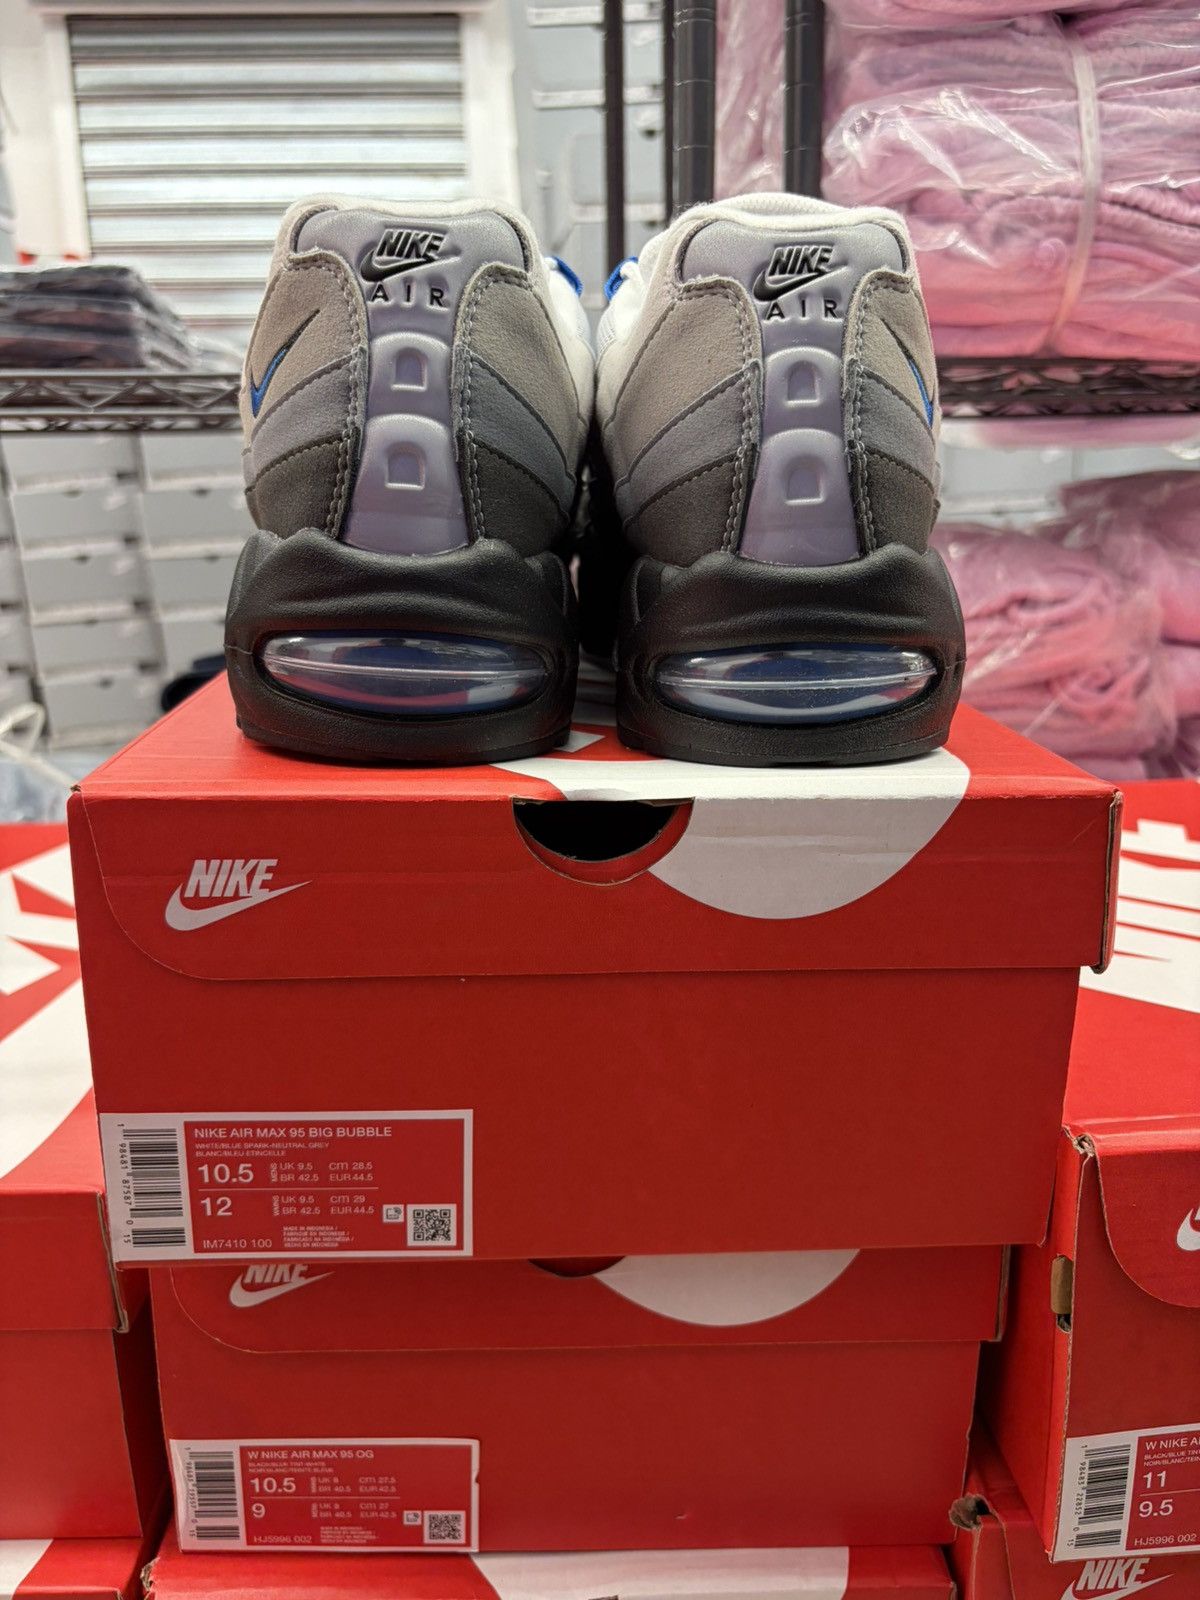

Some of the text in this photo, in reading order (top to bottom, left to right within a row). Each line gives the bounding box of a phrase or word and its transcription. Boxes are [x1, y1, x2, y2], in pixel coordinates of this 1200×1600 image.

[376, 229, 446, 260] NIKE
[768, 246, 834, 276] NIKE
[371, 284, 444, 306] AIR
[766, 300, 838, 320] AIR
[184, 858, 278, 898] NIKE
[194, 1126, 392, 1138] NIKE AIR MAX 95 BIG BUBBLE
[195, 1142, 242, 1150] WHITE/BLUE
[119, 1142, 128, 1170] 98481
[198, 1163, 254, 1184] 10.5
[280, 1162, 295, 1171] UK
[297, 1162, 313, 1170] 9.5
[352, 1162, 373, 1170] 28.5
[280, 1173, 374, 1182] BR 42.5 EUR 44.5
[122, 1179, 132, 1206] 87587
[281, 1196, 296, 1204] UK
[299, 1195, 315, 1204] 9.5
[352, 1195, 366, 1203] 29
[200, 1196, 233, 1216] 12
[282, 1206, 375, 1215] BR 42.5 EUR 44.5
[123, 1234, 131, 1244] 15
[203, 1239, 272, 1249] IM7410 100
[244, 1264, 308, 1284] NIKE
[1145, 1440, 1158, 1450] W
[1160, 1437, 1188, 1448] NIKE
[248, 1450, 374, 1459] W NIKE AIR MAX 95 OG
[250, 1477, 296, 1493] 10.5
[1142, 1470, 1166, 1488] 11
[252, 1503, 266, 1518] 9
[1138, 1499, 1173, 1518] 9.5
[294, 1535, 312, 1543] 002
[1134, 1533, 1197, 1546] HJ5996 002
[1075, 1558, 1150, 1590] NIKE
